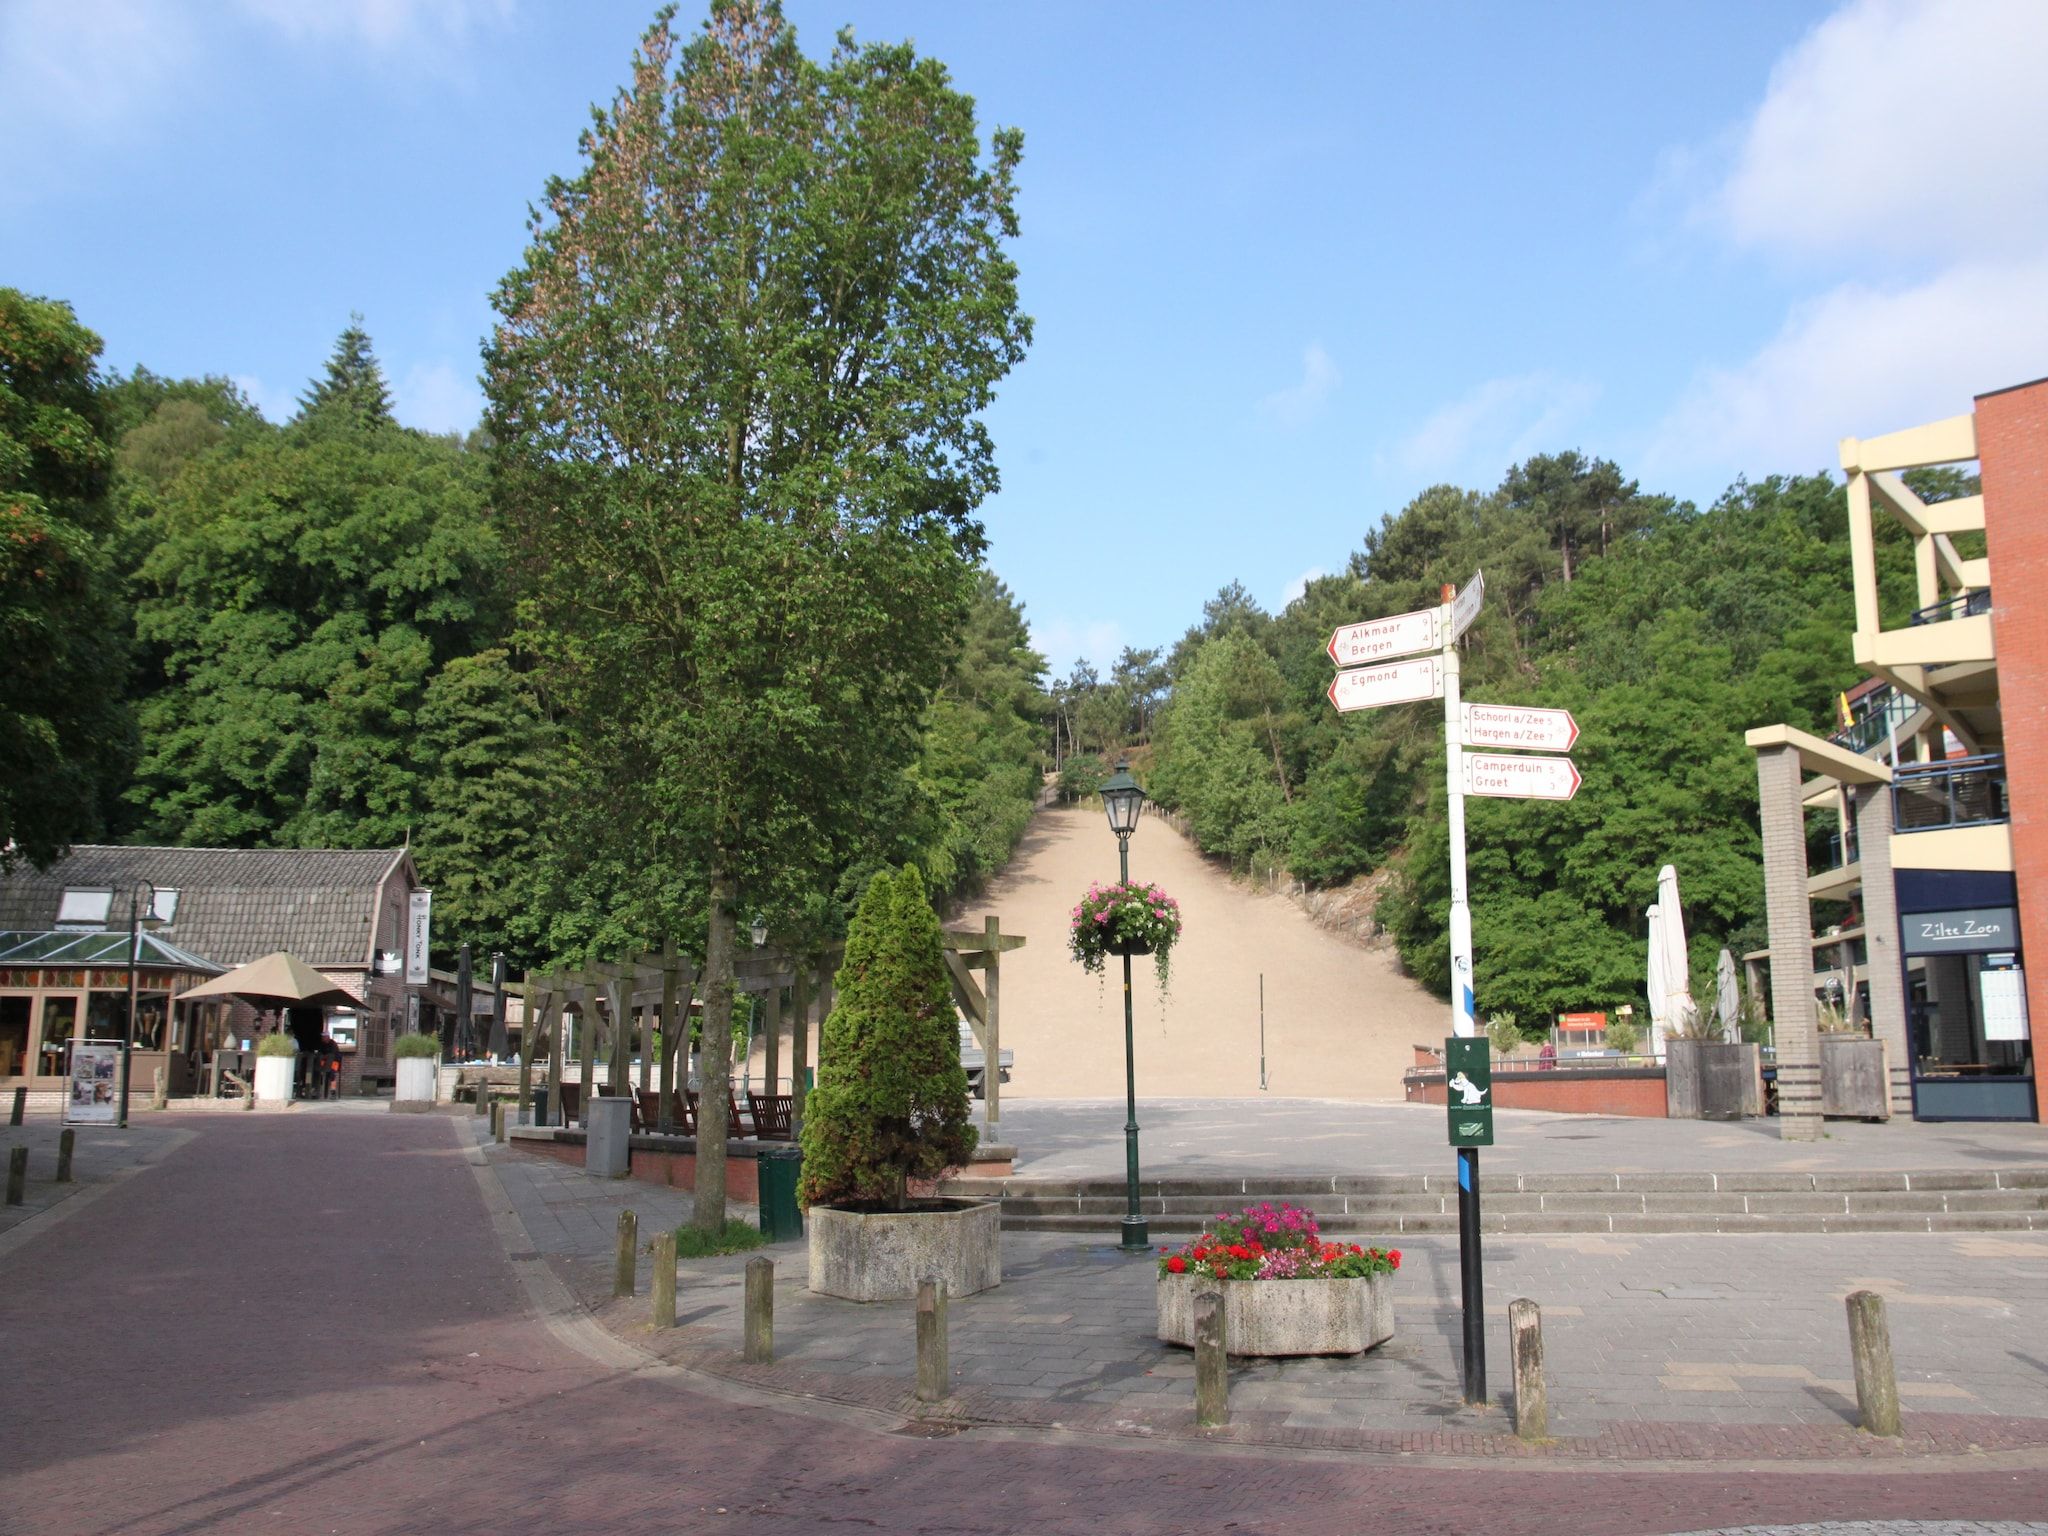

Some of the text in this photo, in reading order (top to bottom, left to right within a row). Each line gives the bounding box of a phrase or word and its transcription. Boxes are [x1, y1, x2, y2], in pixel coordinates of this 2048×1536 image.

[1351, 618, 1428, 640] Alkmaar 9
[1351, 640, 1393, 656] Bergen
[1351, 669, 1398, 687] Egmond
[1473, 710, 1511, 723] Schoorl
[1513, 713, 1545, 725] a/Zee
[1474, 727, 1511, 740] Hargen
[1513, 729, 1545, 741] a/Zee
[1475, 759, 1543, 774] Camperduin
[1475, 775, 1508, 788] Groet
[1964, 920, 2001, 935] Zoen
